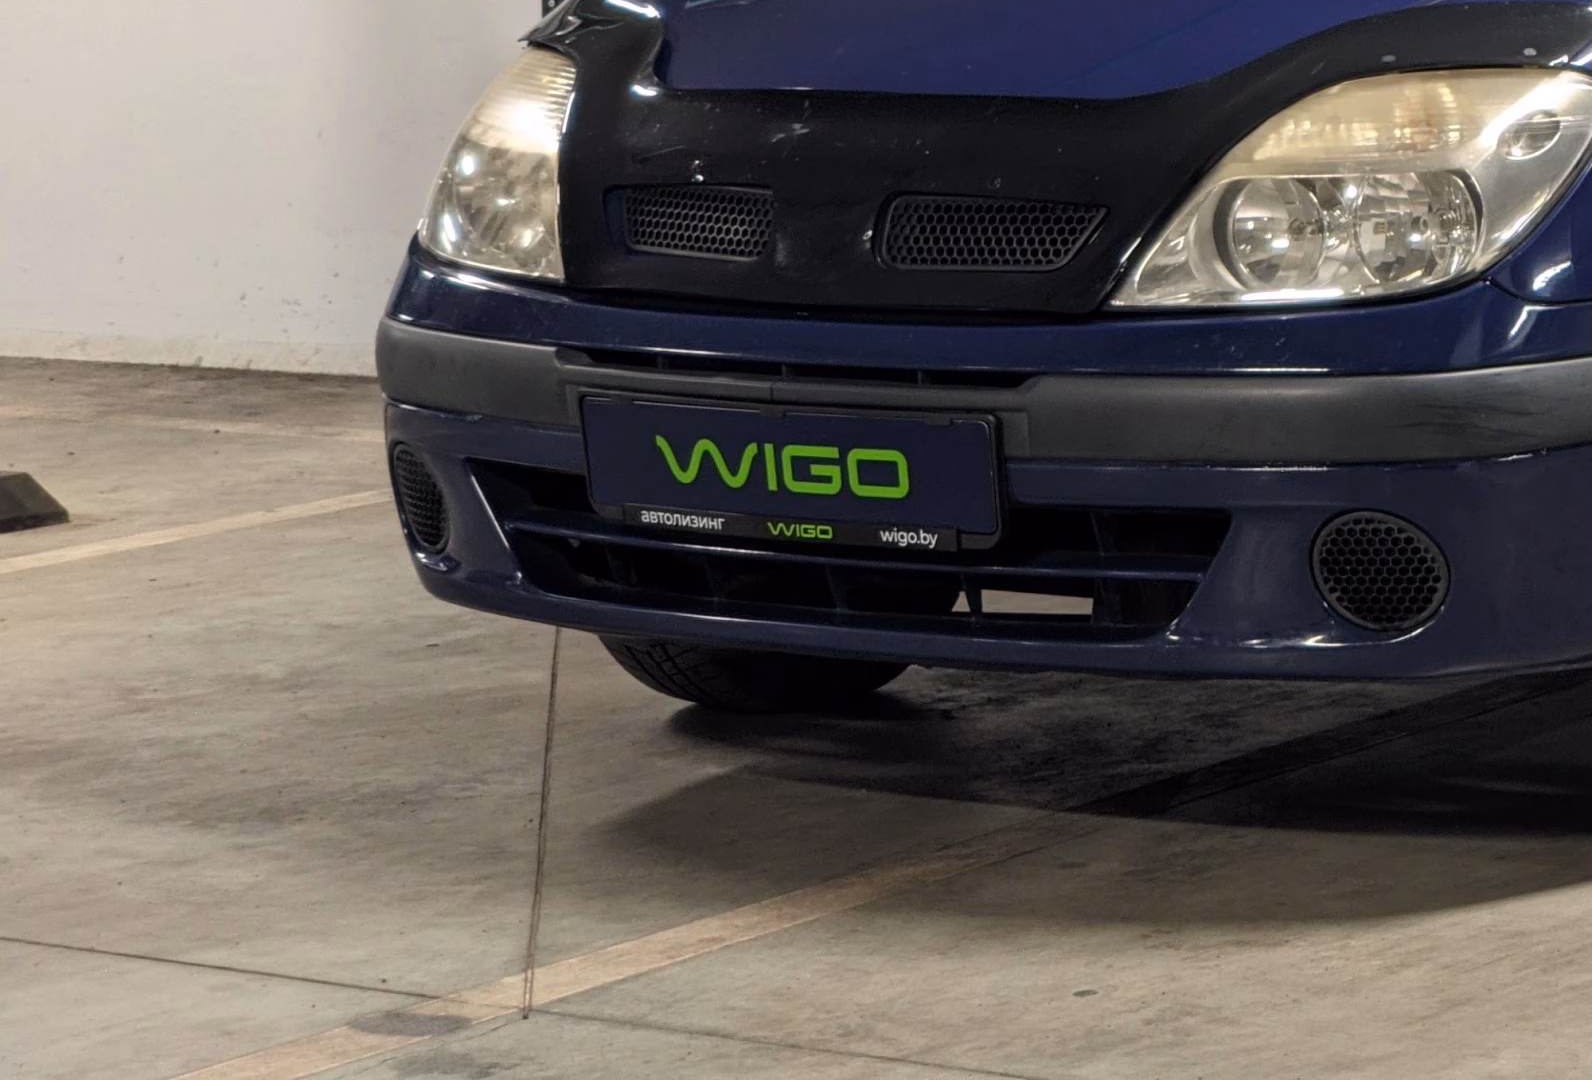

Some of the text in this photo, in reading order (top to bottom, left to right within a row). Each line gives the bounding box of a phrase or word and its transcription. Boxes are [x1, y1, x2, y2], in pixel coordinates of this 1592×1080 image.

[655, 434, 910, 499] WIGO
[640, 508, 726, 531] автолизинг
[766, 520, 833, 540] WIGO
[879, 527, 939, 549] wigo.by
